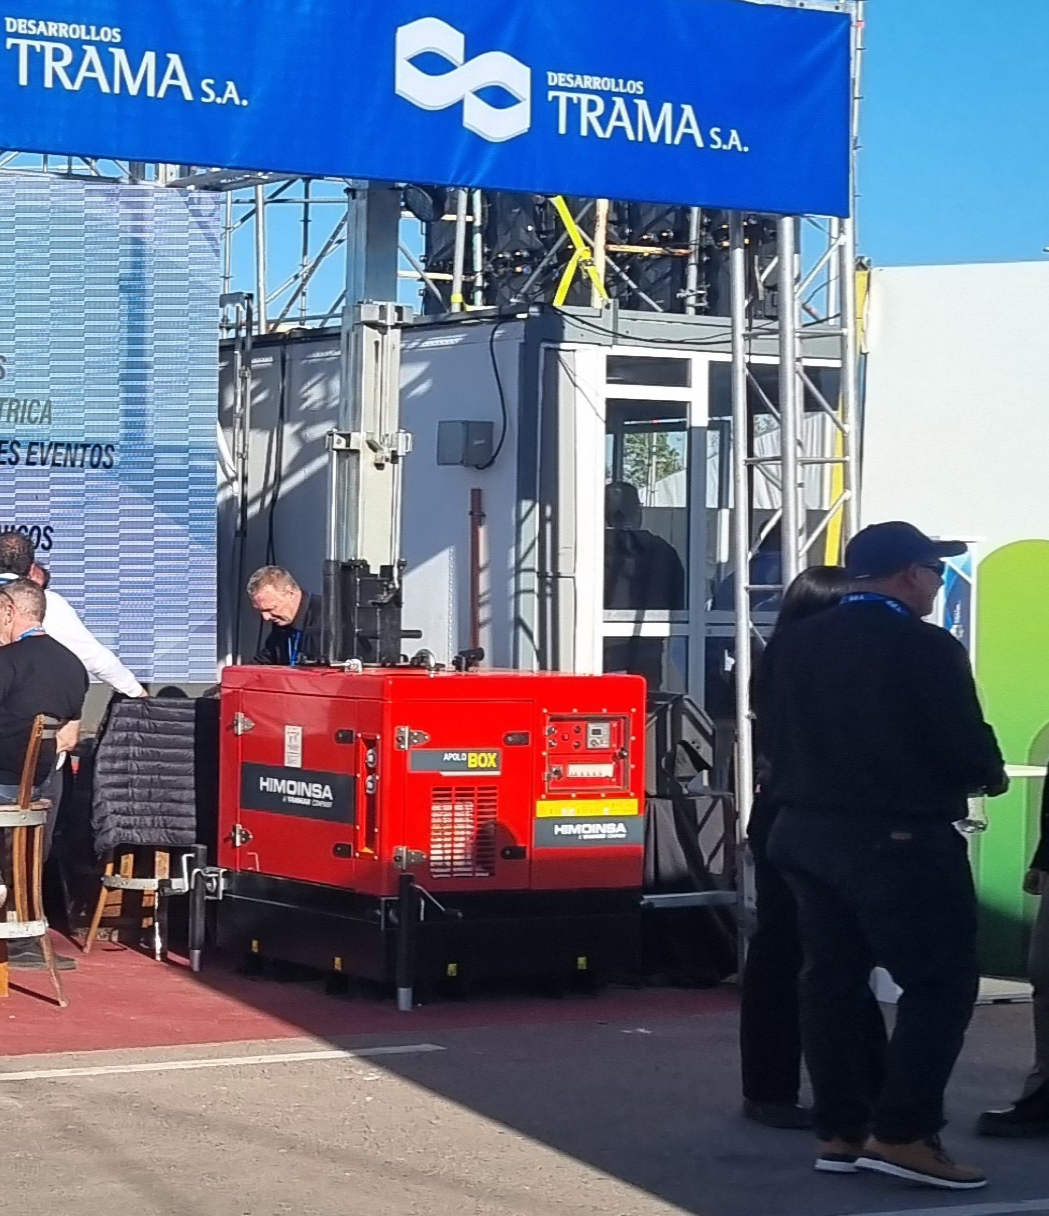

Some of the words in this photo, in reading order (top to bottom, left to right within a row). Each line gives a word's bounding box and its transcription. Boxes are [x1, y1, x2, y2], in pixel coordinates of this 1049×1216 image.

[5, 16, 121, 43] DESARROLLOS
[6, 37, 194, 101] TRAMA
[200, 78, 249, 107] S.A.
[546, 71, 644, 95] DESARROLLOS
[547, 90, 704, 148] TRAMA
[709, 127, 749, 152] S.A.
[25, 440, 116, 469] EVENTOS
[467, 752, 497, 769] BOX
[259, 776, 334, 801] HIMOINSA
[554, 822, 628, 835] HIMOINSA
